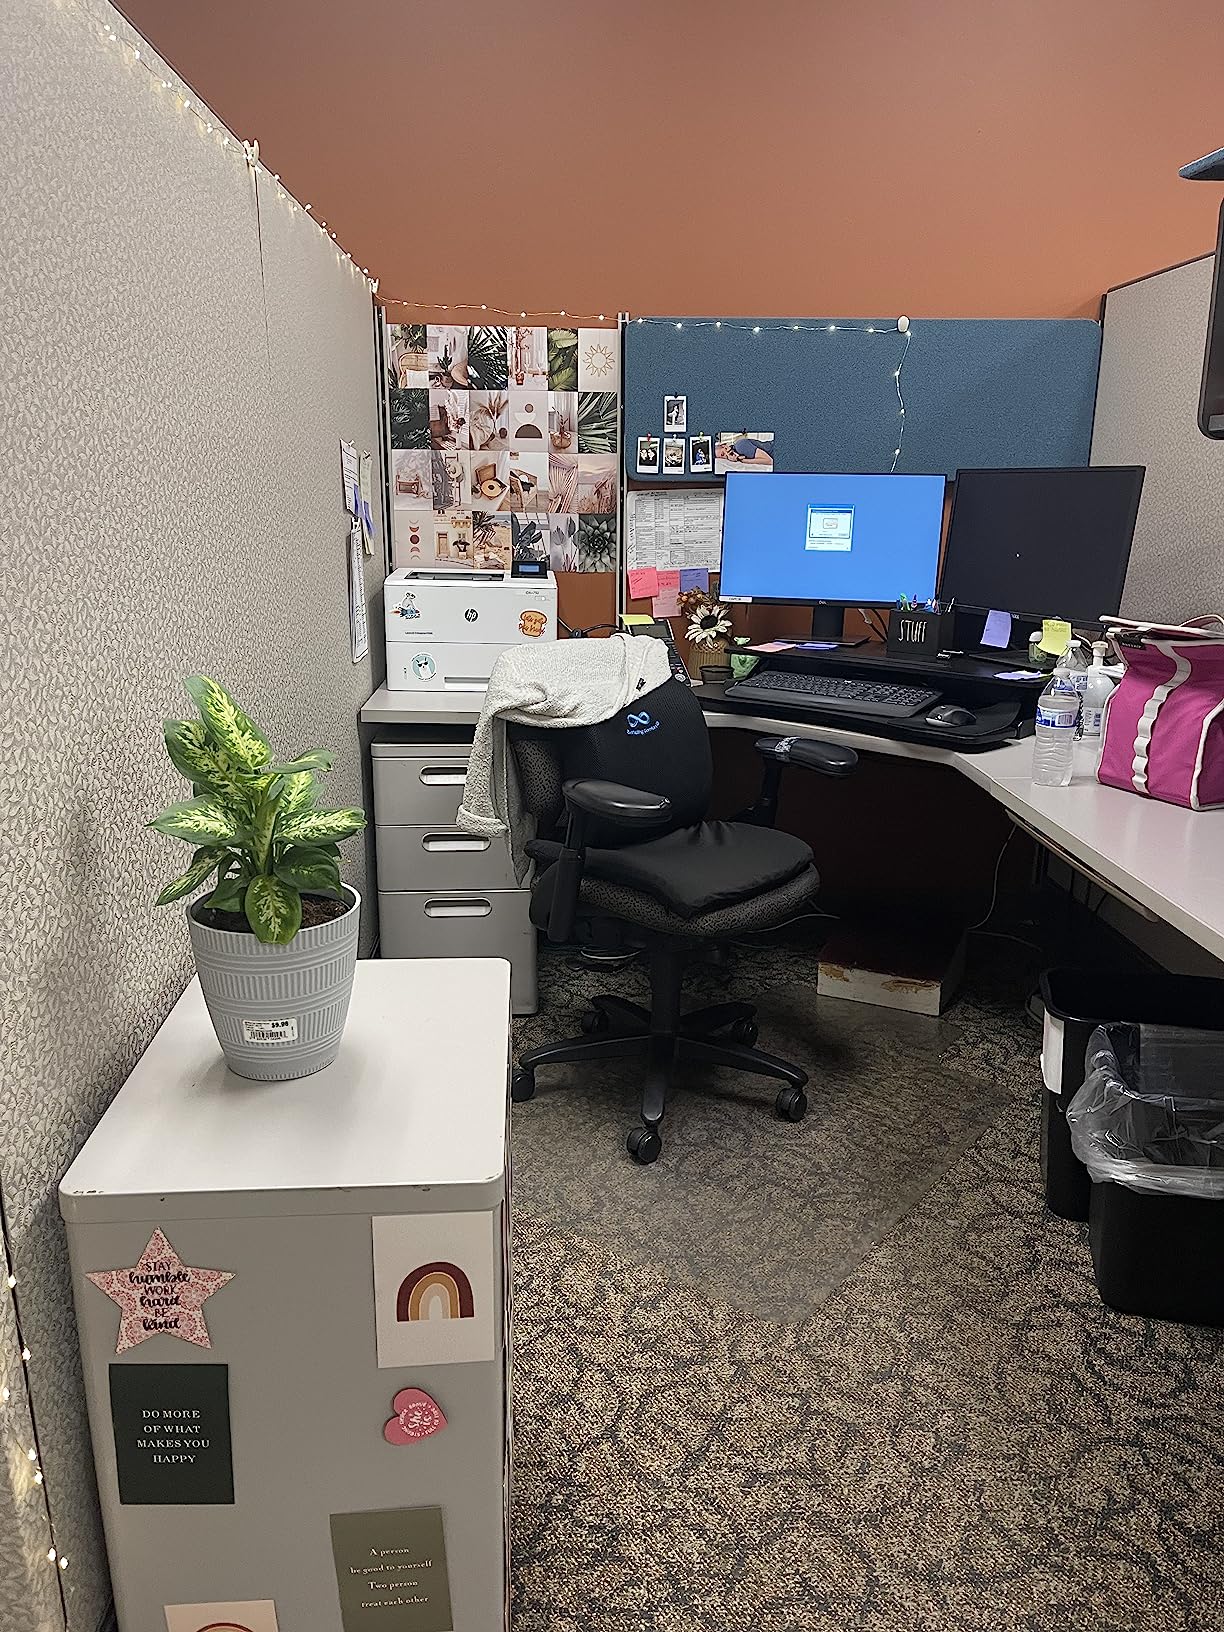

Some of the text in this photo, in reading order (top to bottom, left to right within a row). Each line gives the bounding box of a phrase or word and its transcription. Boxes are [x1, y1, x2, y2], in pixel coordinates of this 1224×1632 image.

[898, 620, 927, 642] STUFF
[146, 1261, 172, 1273] STAY
[128, 1270, 191, 1285] humble
[144, 1284, 178, 1295] WORK
[140, 1296, 181, 1308] hard
[154, 1308, 169, 1318] BE
[142, 1317, 181, 1331] kind
[142, 1410, 201, 1419] DO MORE
[408, 1410, 422, 1428] She
[143, 1425, 201, 1434] OF WHAT
[137, 1439, 210, 1448] MAKES YOU
[153, 1454, 196, 1463] HAPPY
[370, 1547, 409, 1557] A person
[350, 1566, 361, 1574] be
[362, 1563, 384, 1575] good
[397, 1559, 432, 1572] yourself
[368, 1581, 418, 1591] Two person
[361, 1600, 382, 1608] treat
[405, 1595, 429, 1604] other
